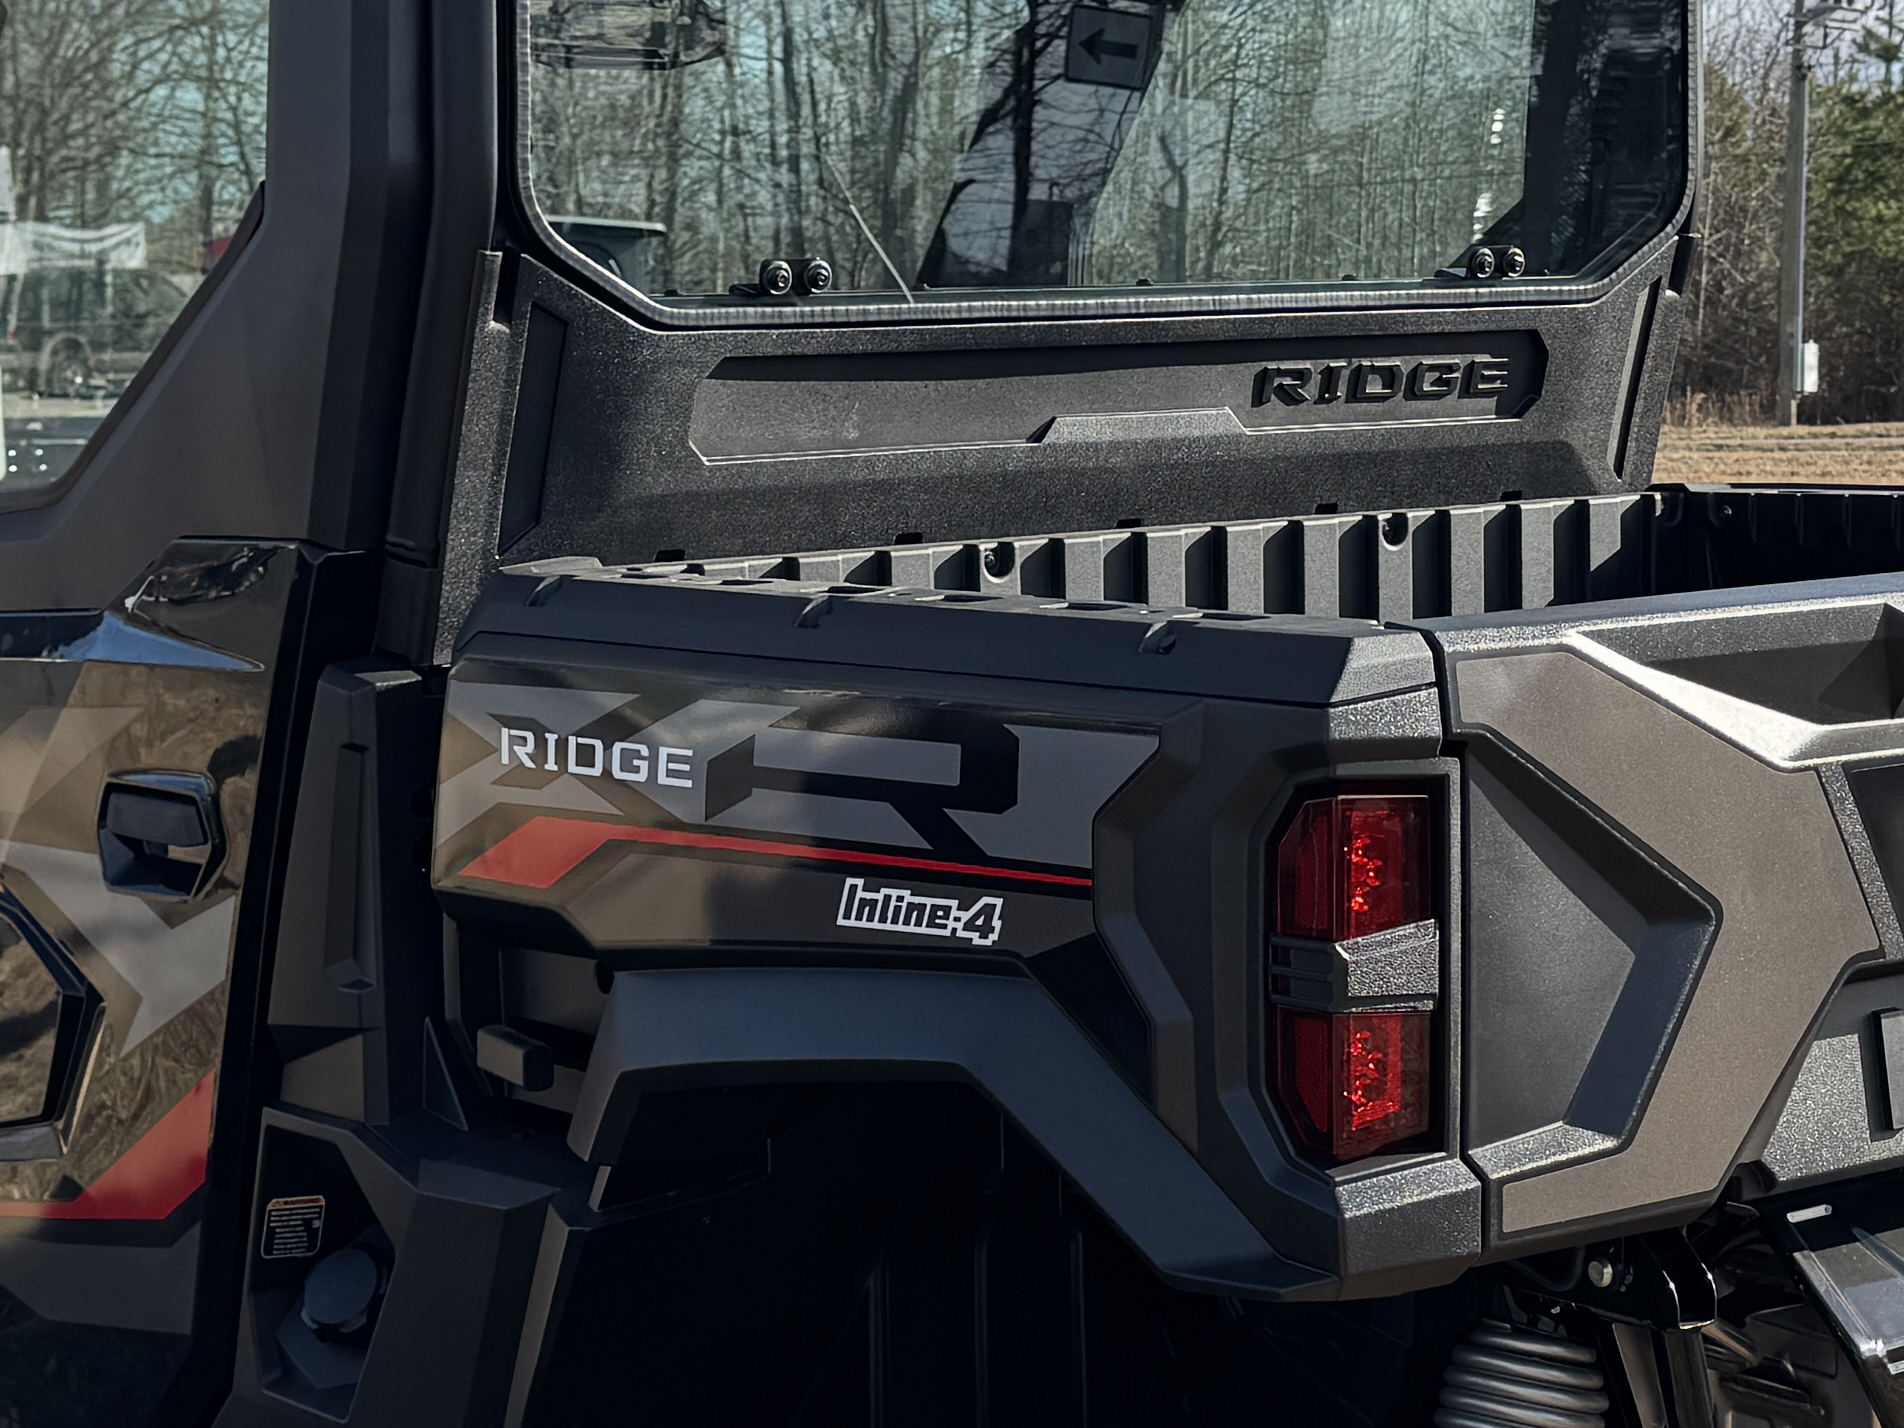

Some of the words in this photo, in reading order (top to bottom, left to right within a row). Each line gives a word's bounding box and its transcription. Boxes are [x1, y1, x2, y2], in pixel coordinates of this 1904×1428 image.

[1250, 357, 1510, 408] RIDGE
[500, 726, 694, 788] RIDGE
[836, 876, 1004, 946] Inline-4
